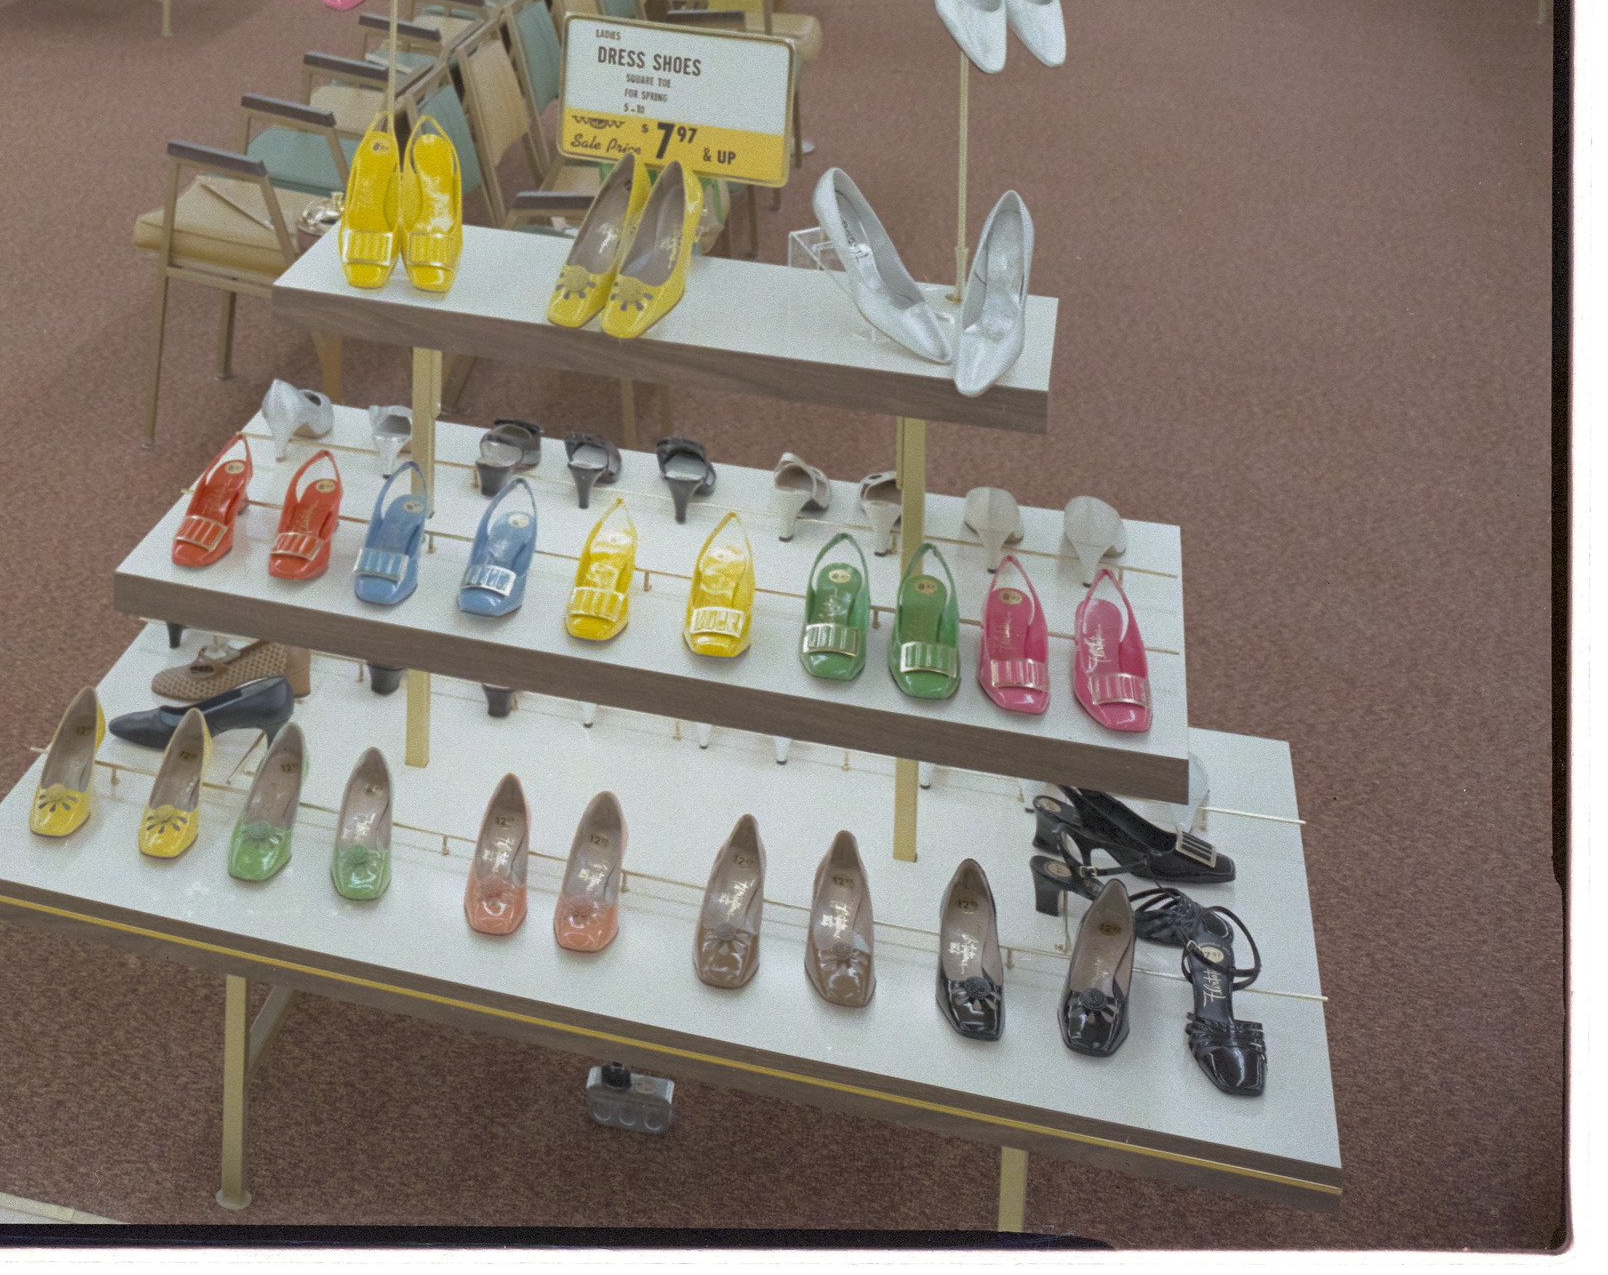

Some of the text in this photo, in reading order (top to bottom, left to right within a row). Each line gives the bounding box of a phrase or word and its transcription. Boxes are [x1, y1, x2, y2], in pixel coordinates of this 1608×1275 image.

[596, 29, 621, 41] LADIES
[598, 46, 701, 76] DRESS SHOES
[626, 74, 671, 88] SQUARE TOE
[624, 88, 668, 102] FOR SPRING
[571, 134, 642, 156] Sale Price
[703, 148, 736, 165] & UP
